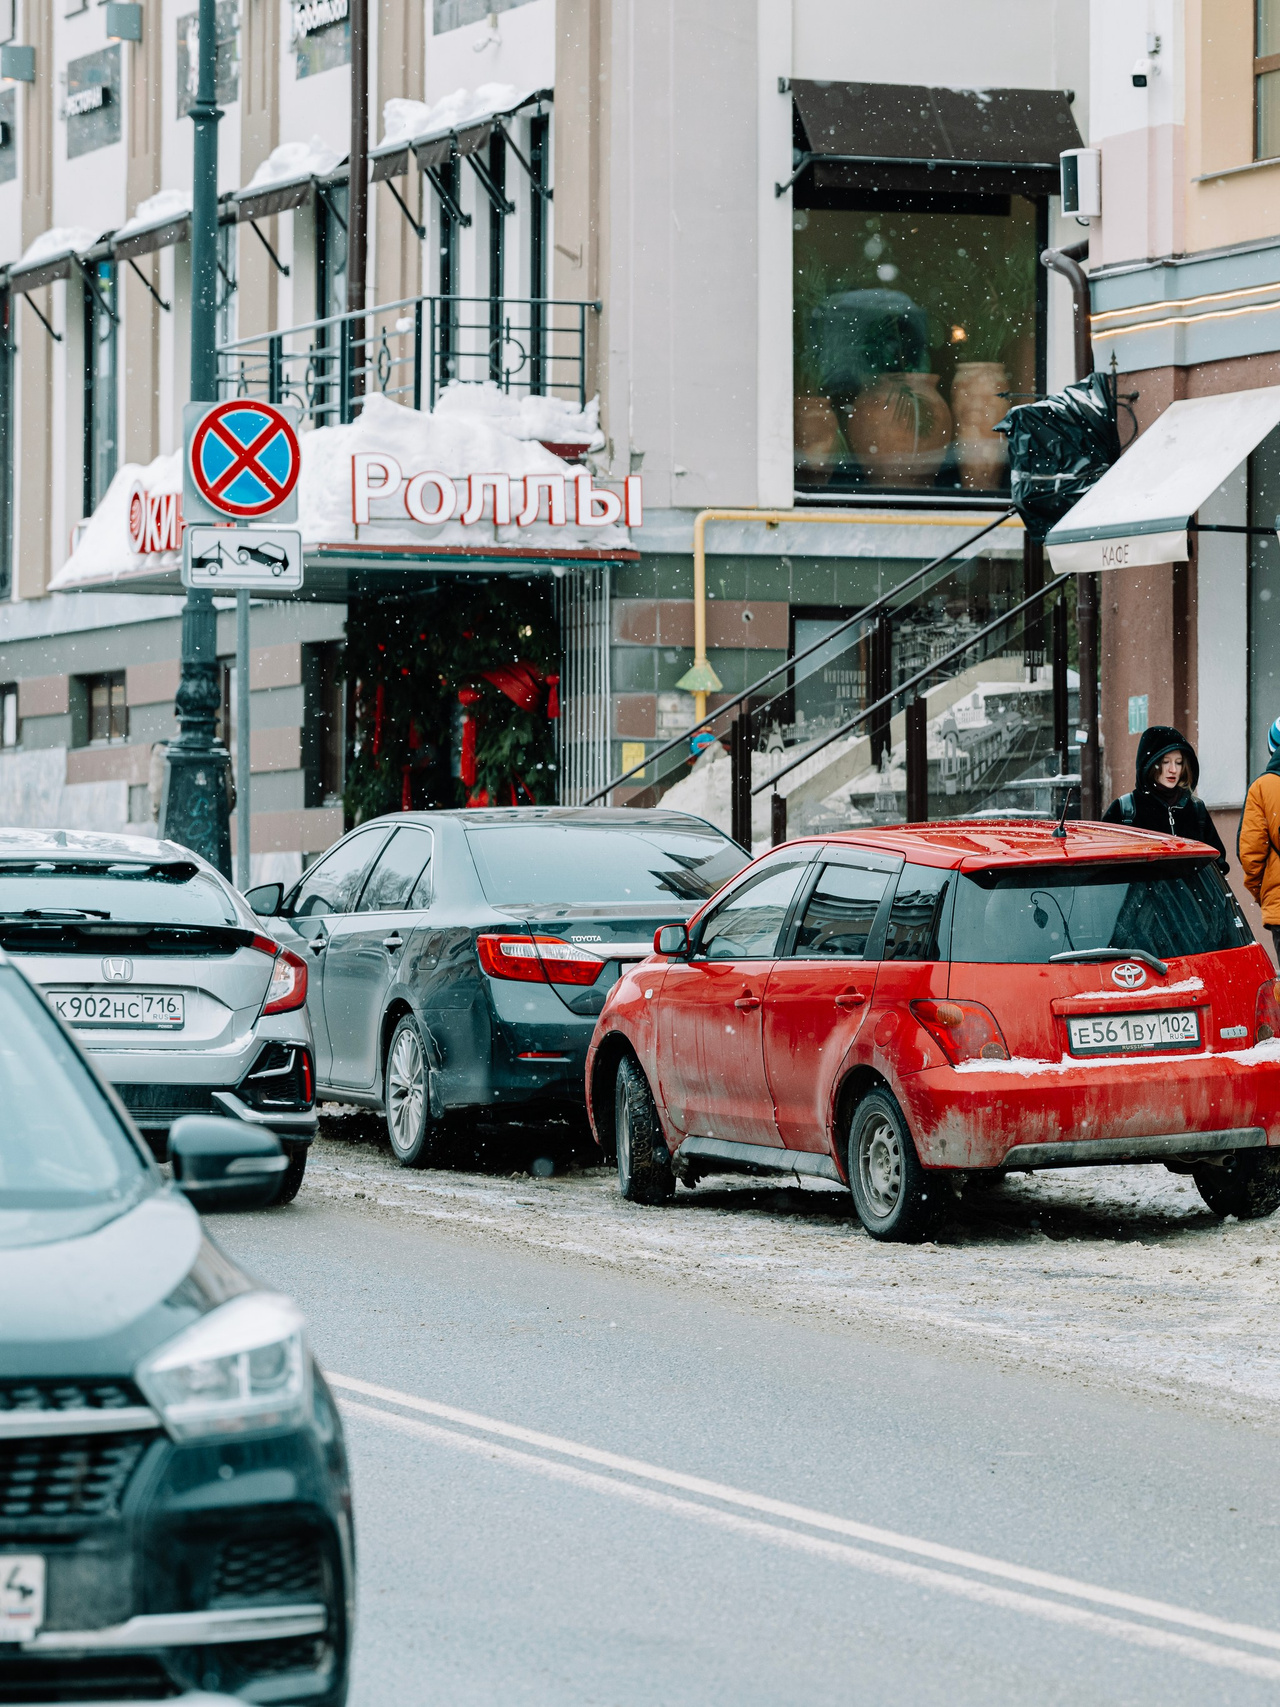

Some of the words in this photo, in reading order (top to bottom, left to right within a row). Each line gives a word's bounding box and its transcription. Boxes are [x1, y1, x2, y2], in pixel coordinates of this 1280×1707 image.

[1102, 544, 1129, 566] КАФЕ
[56, 997, 140, 1018] К902НС
[144, 997, 176, 1013] 716
[1078, 1020, 1156, 1044] Е561ВУ
[1162, 1016, 1191, 1033] 102
[1169, 1032, 1184, 1040] RUS
